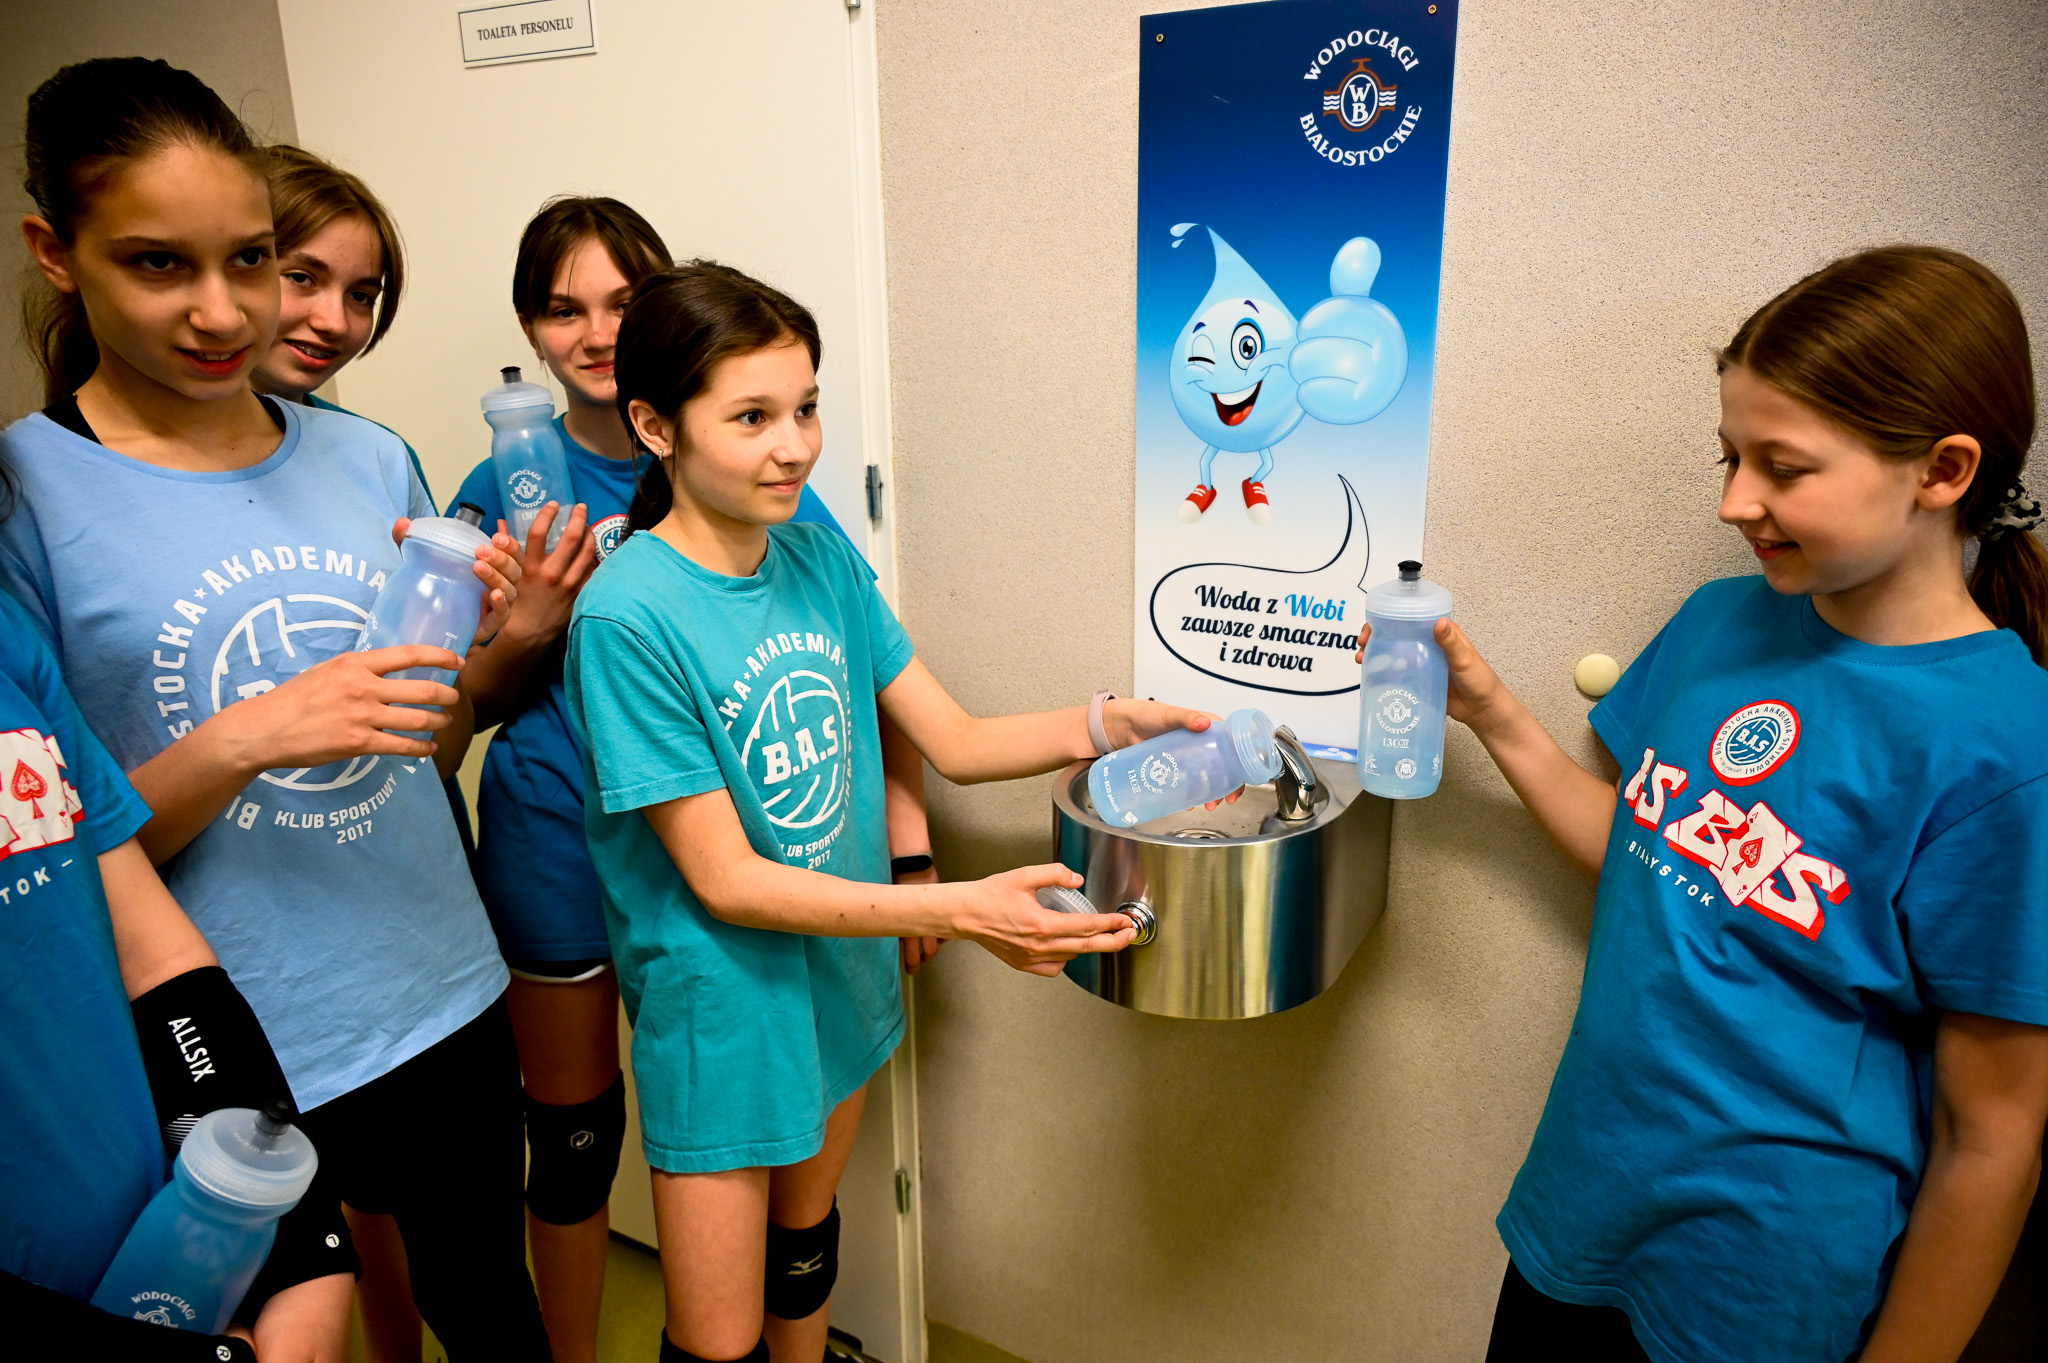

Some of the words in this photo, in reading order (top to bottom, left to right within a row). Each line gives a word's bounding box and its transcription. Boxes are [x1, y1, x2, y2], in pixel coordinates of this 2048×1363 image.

[477, 25, 517, 41] TOALETA
[520, 17, 573, 36] PERSONELU
[1303, 28, 1420, 80] WODOCIĄGI
[1300, 105, 1423, 167] BIAŁOSTOCKIE
[201, 545, 388, 596] AKADEMIA
[1194, 584, 1261, 612] Woda
[1266, 598, 1279, 614] z
[1284, 593, 1346, 622] Wobi
[1181, 615, 1255, 639] zawsze
[1258, 624, 1359, 651] smaczna
[745, 632, 841, 678] AKADEMIA
[1219, 641, 1228, 662] i
[1231, 645, 1313, 673] zdrowa
[762, 714, 839, 785] B.A.S
[1735, 728, 1770, 753] B.A.S
[274, 809, 325, 829] KLUB
[328, 772, 397, 827] SPORTOWY
[336, 820, 374, 845] 2017
[779, 843, 803, 858] LUB
[804, 813, 847, 856] SPORTOWY
[807, 850, 832, 870] 2017
[168, 1017, 216, 1083] ALLSIX
[218, 1348, 230, 1358] R
